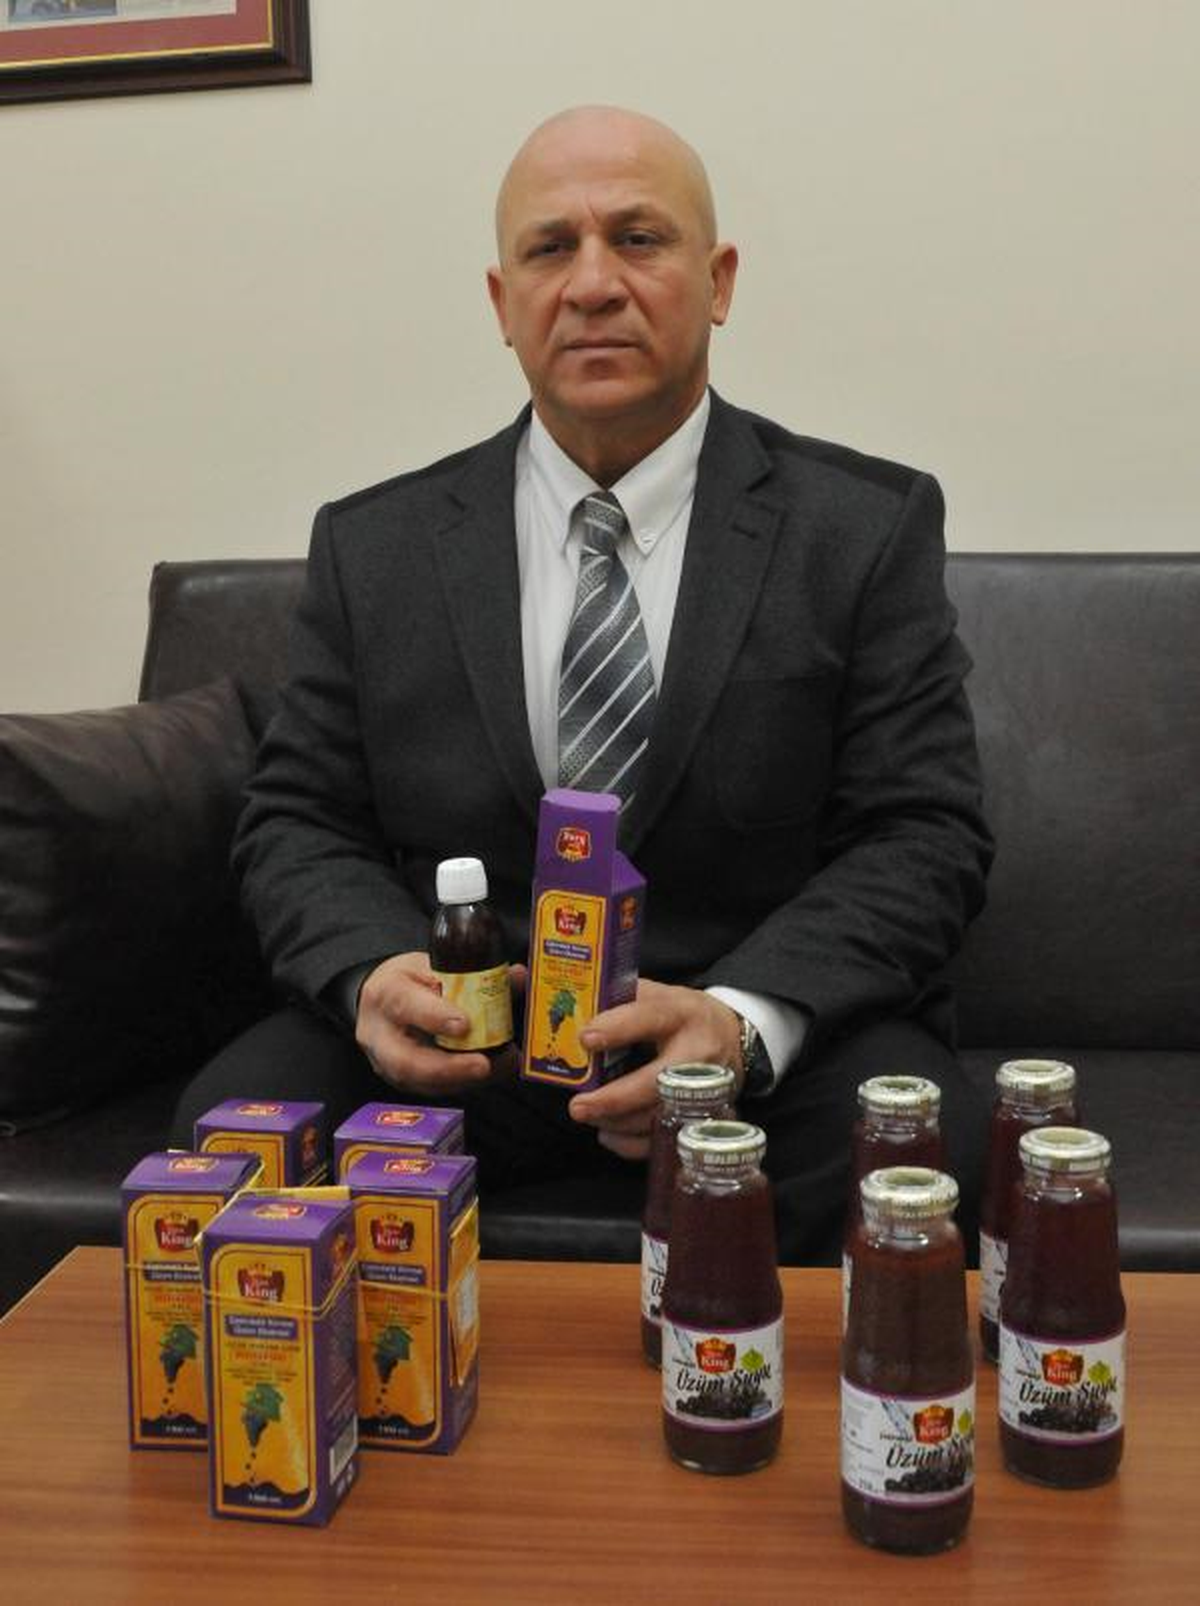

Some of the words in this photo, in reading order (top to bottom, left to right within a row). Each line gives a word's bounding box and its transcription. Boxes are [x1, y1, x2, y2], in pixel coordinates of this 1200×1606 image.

[161, 1230, 193, 1249] King
[376, 1231, 409, 1251] King
[243, 1281, 279, 1302] King
[701, 1355, 731, 1369] King
[677, 1367, 725, 1395] Üzüm
[1046, 1366, 1079, 1382] King
[1019, 1377, 1072, 1407] Üzüm
[886, 1442, 944, 1470] Üzüm
